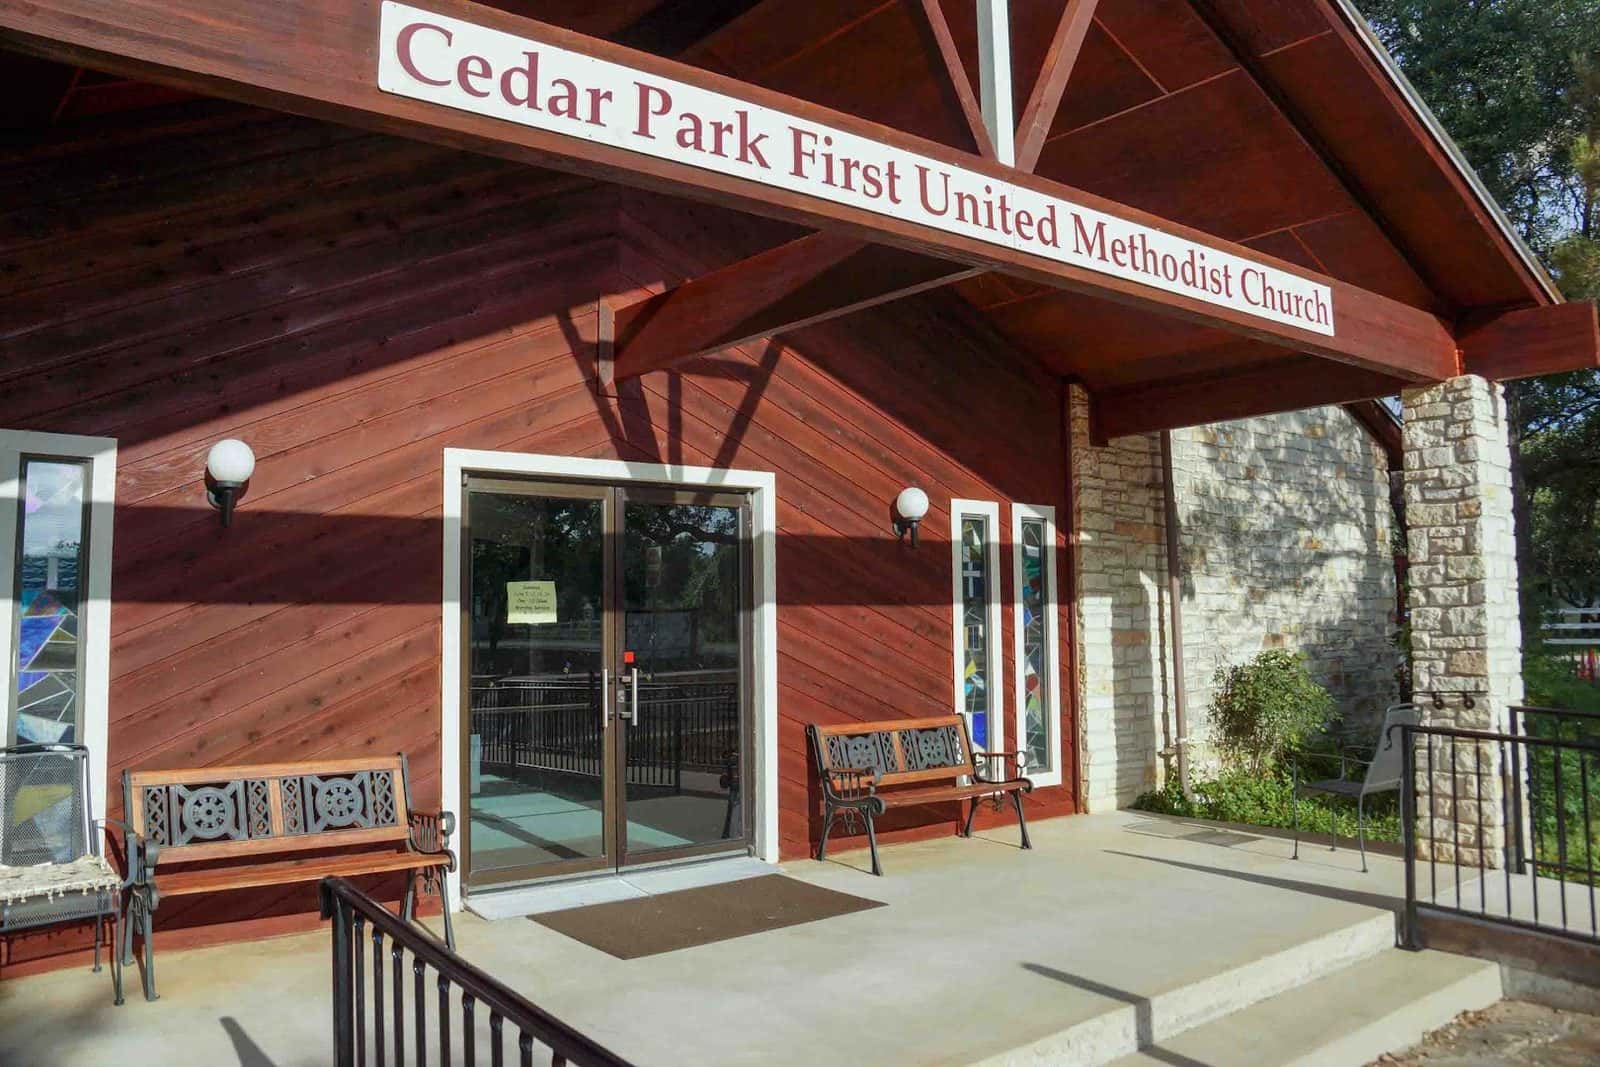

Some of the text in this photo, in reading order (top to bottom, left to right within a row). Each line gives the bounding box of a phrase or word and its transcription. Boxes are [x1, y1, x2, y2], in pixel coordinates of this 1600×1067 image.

[397, 23, 1332, 326] Cedar Park First United Methodist Church
